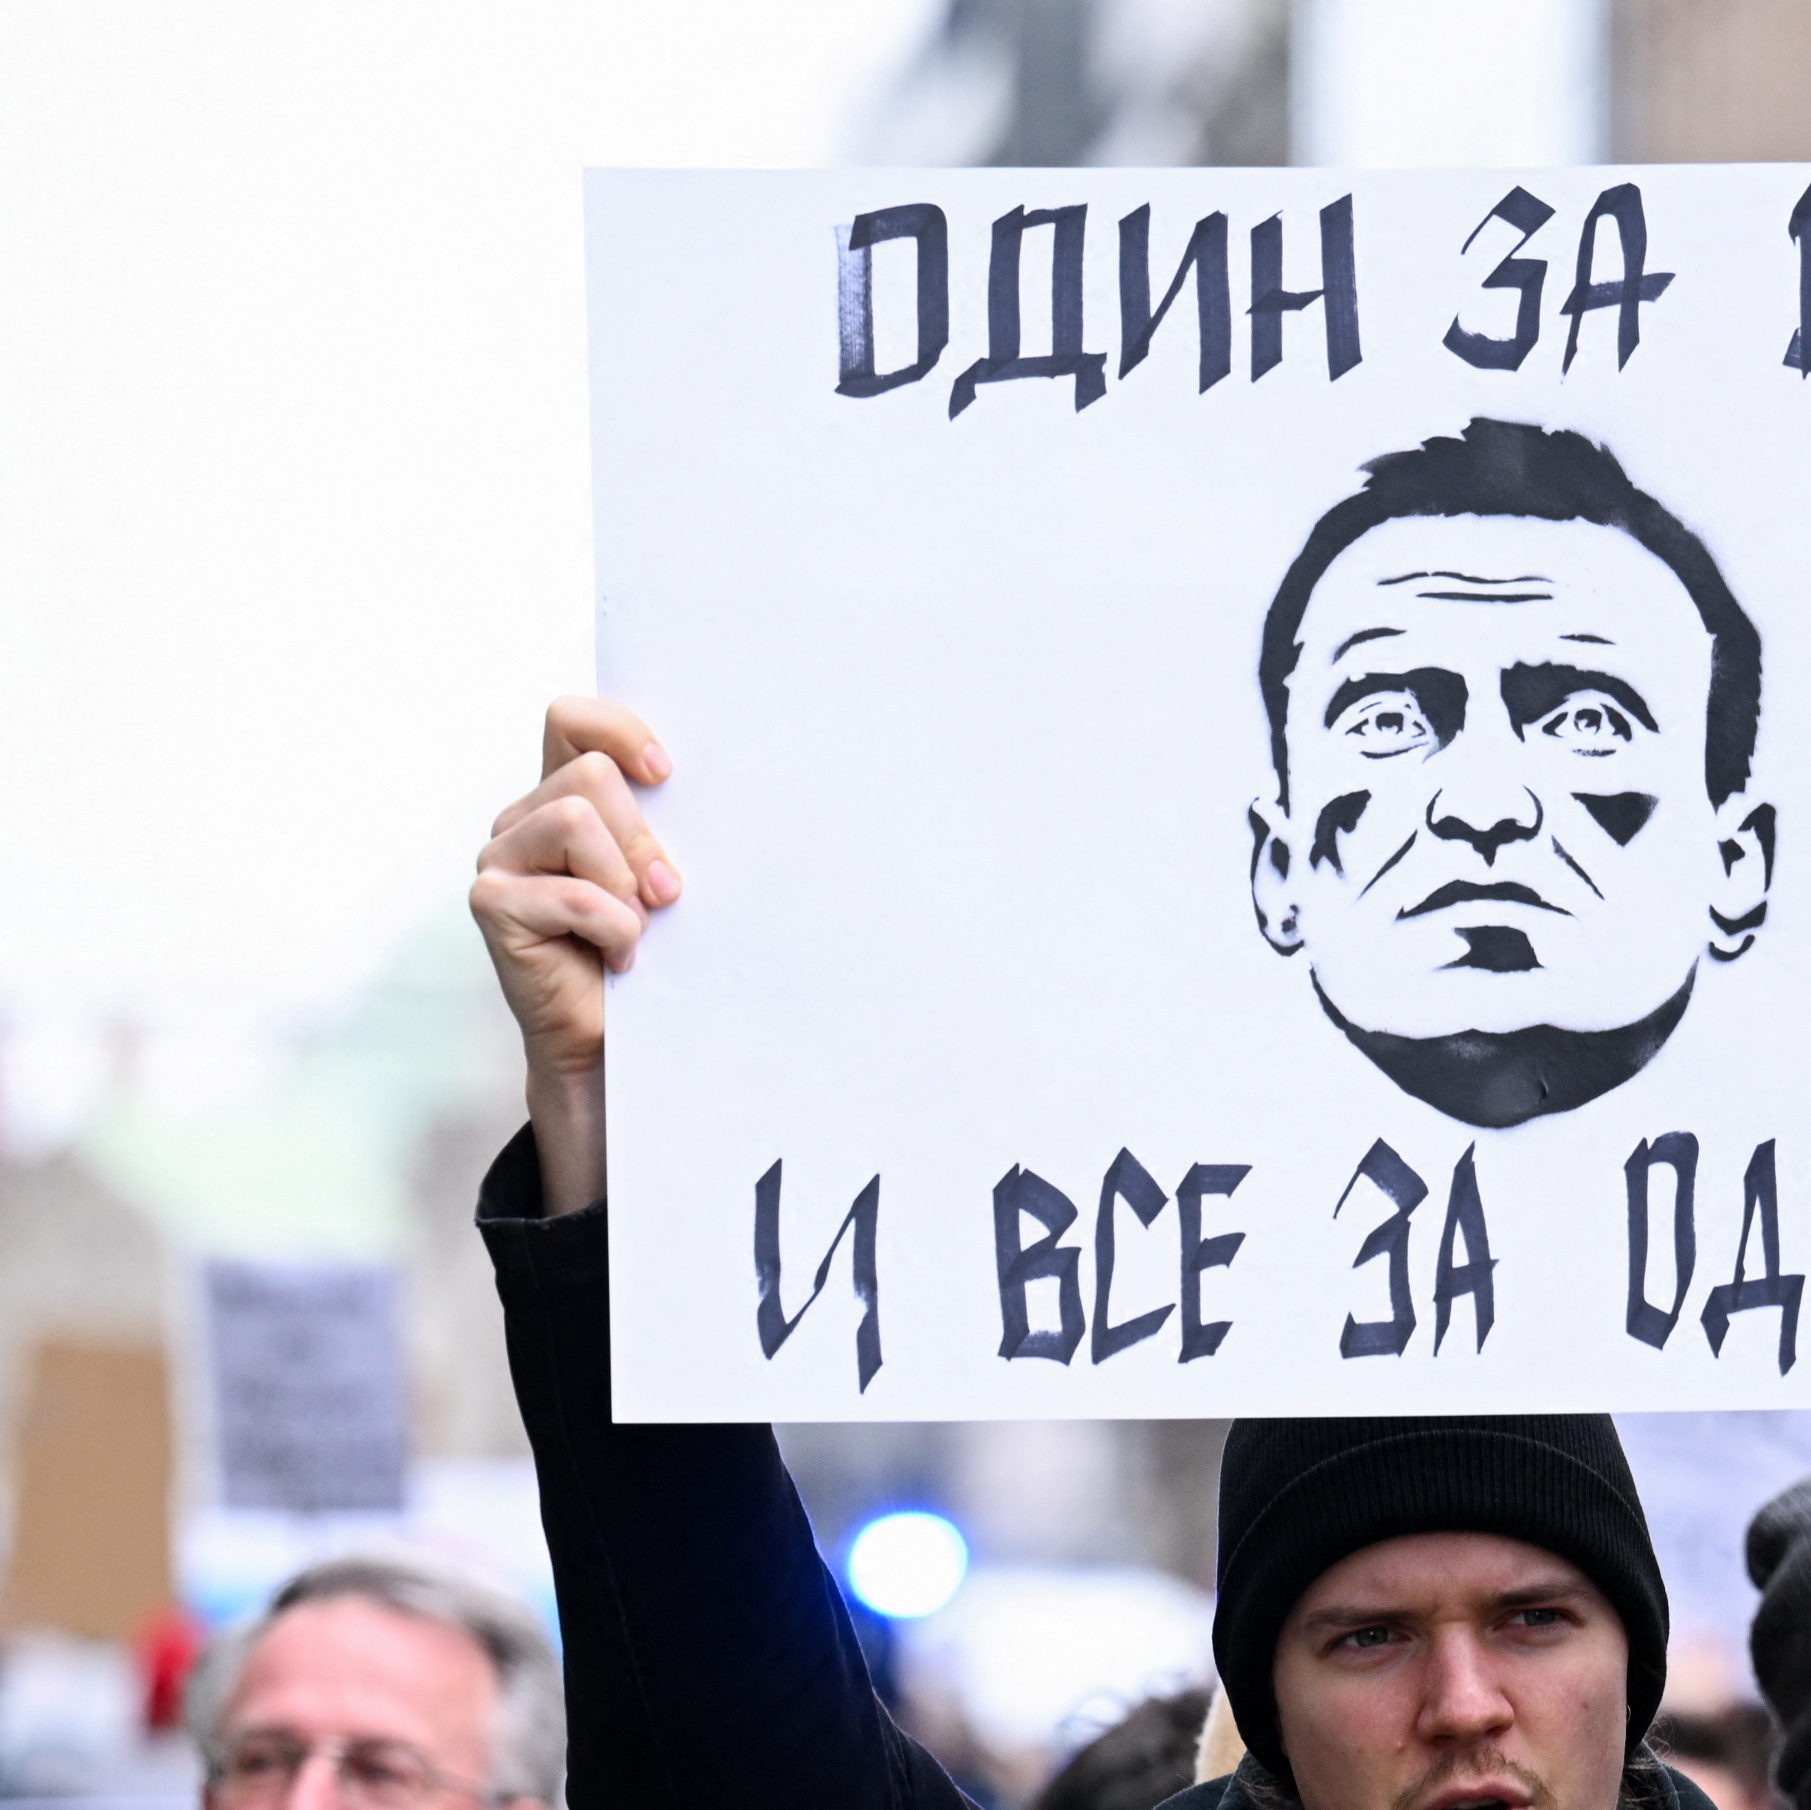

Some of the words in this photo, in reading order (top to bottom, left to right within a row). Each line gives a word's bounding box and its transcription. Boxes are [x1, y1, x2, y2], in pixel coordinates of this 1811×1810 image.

[833, 191, 1364, 420] ОДИН
[1442, 182, 1677, 376] ЗА
[753, 1157, 884, 1395] И
[992, 1146, 1253, 1367] ВСЕ
[1332, 1137, 1500, 1360] ЗА
